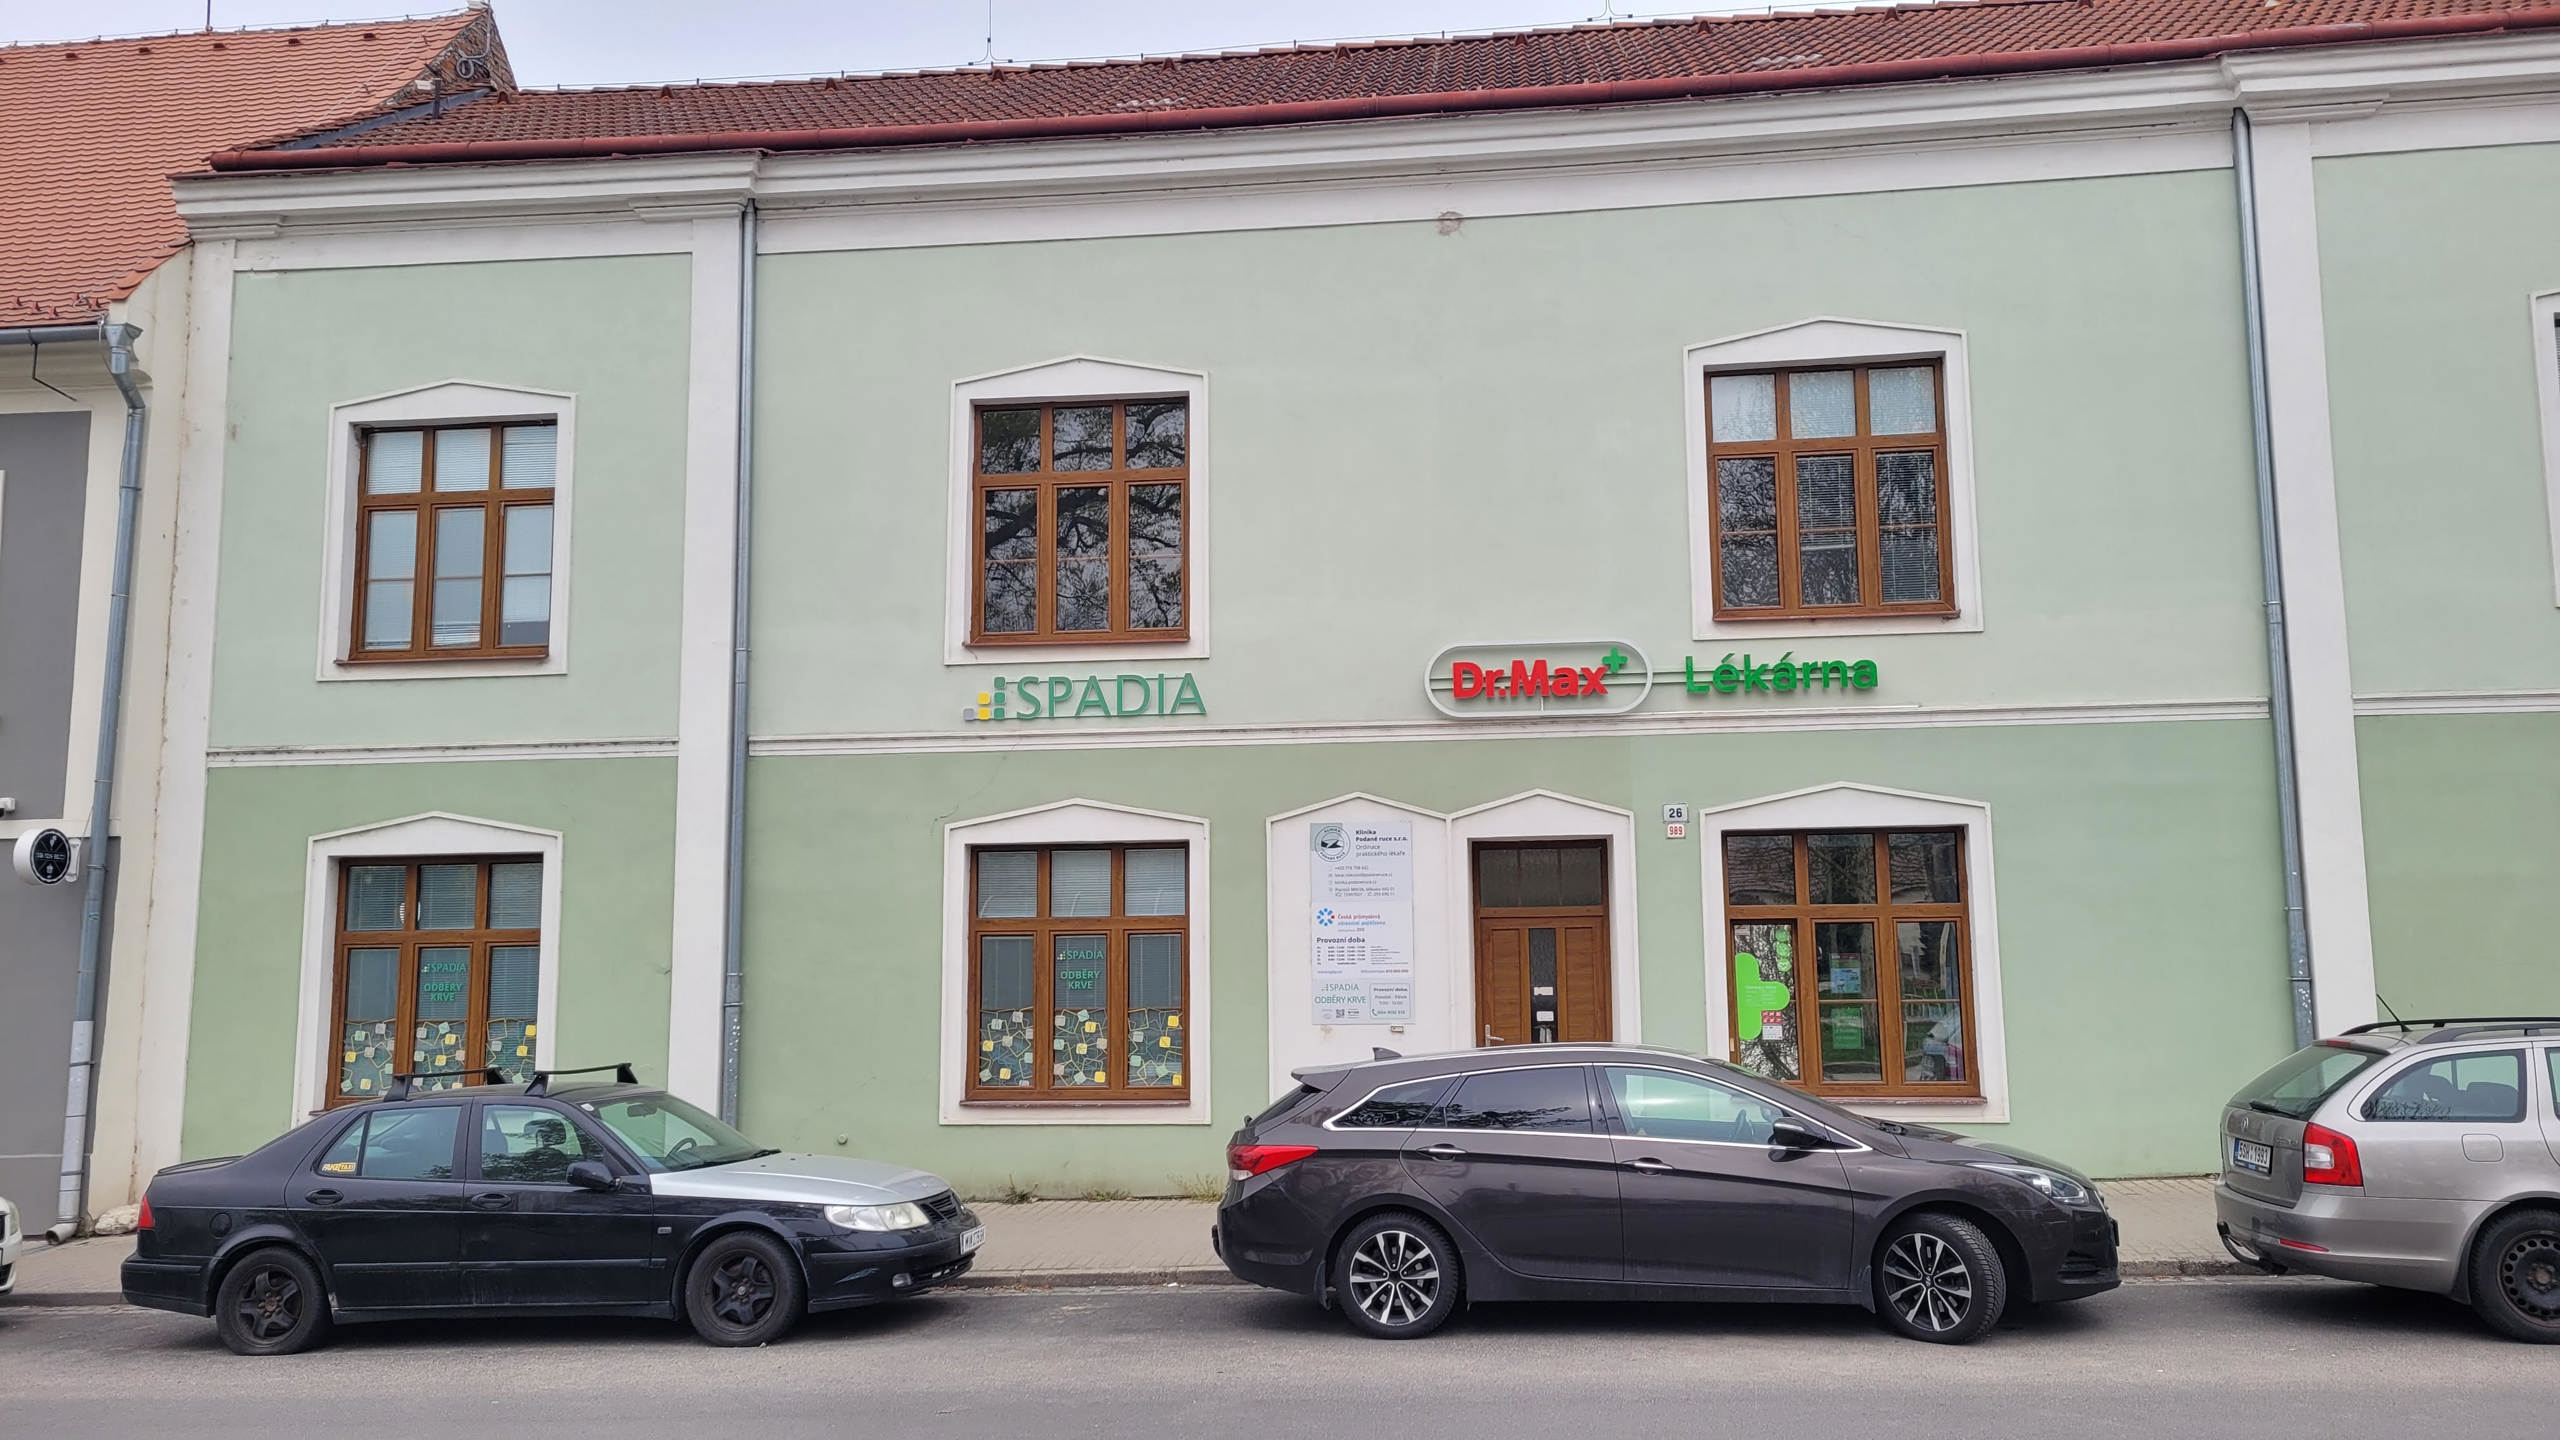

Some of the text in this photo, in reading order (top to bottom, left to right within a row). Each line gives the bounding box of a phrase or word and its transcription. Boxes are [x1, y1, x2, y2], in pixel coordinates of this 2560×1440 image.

[1685, 651, 1878, 694] Lékárna
[1452, 659, 1609, 699] Dr.Max
[1668, 807, 1683, 819] 26
[1669, 825, 1683, 836] 989
[1068, 981, 1093, 990] KRVE
[431, 992, 455, 1001] KRVE
[1314, 994, 1367, 1004] ODBĚRY KRVE
